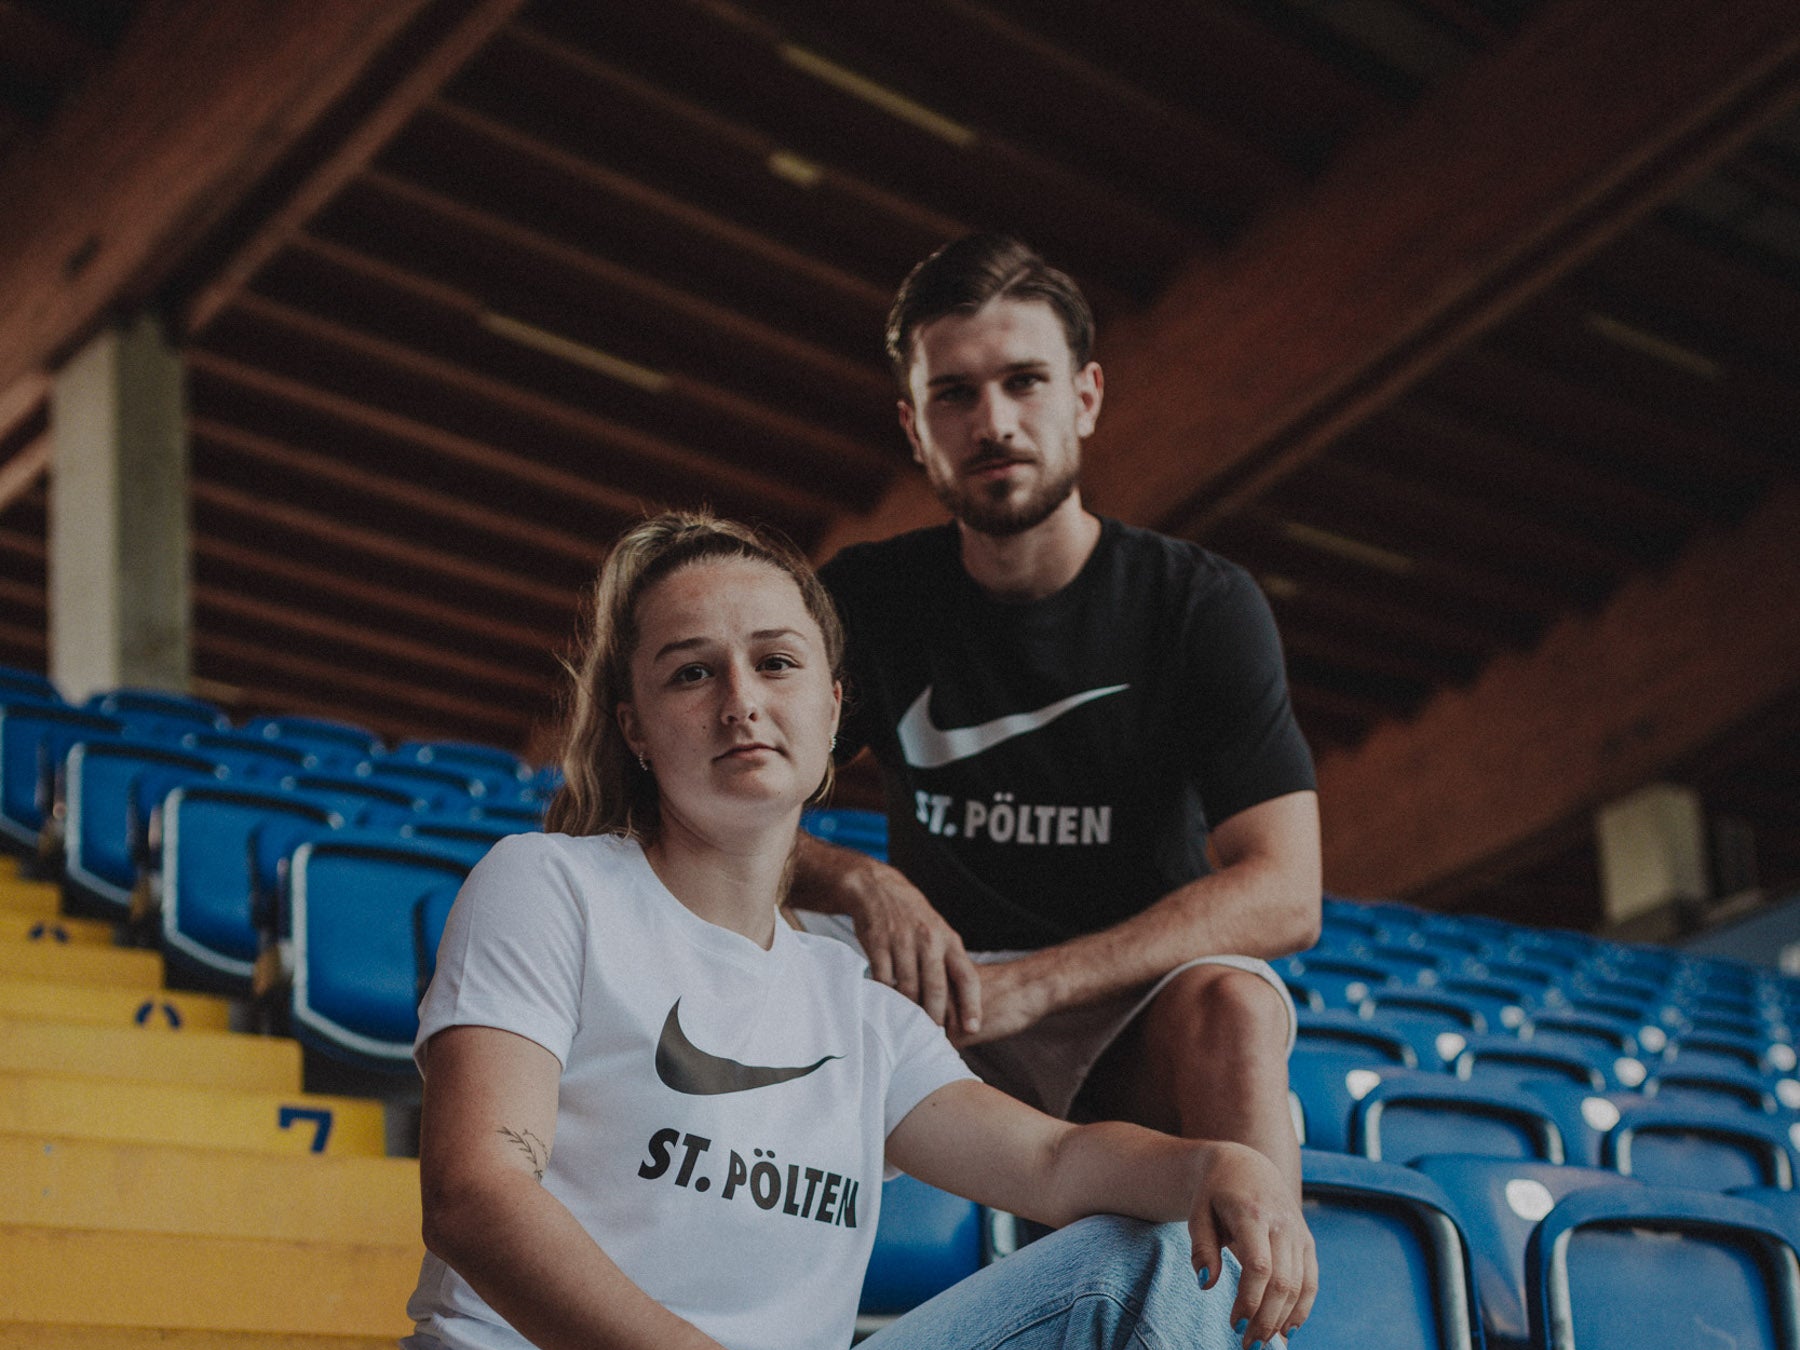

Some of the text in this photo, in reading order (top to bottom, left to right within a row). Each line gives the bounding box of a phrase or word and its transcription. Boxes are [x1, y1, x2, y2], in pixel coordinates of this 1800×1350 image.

[915, 790, 1112, 845] ST. PÖLTEN
[637, 1127, 860, 1229] ST. PÖLTEN
